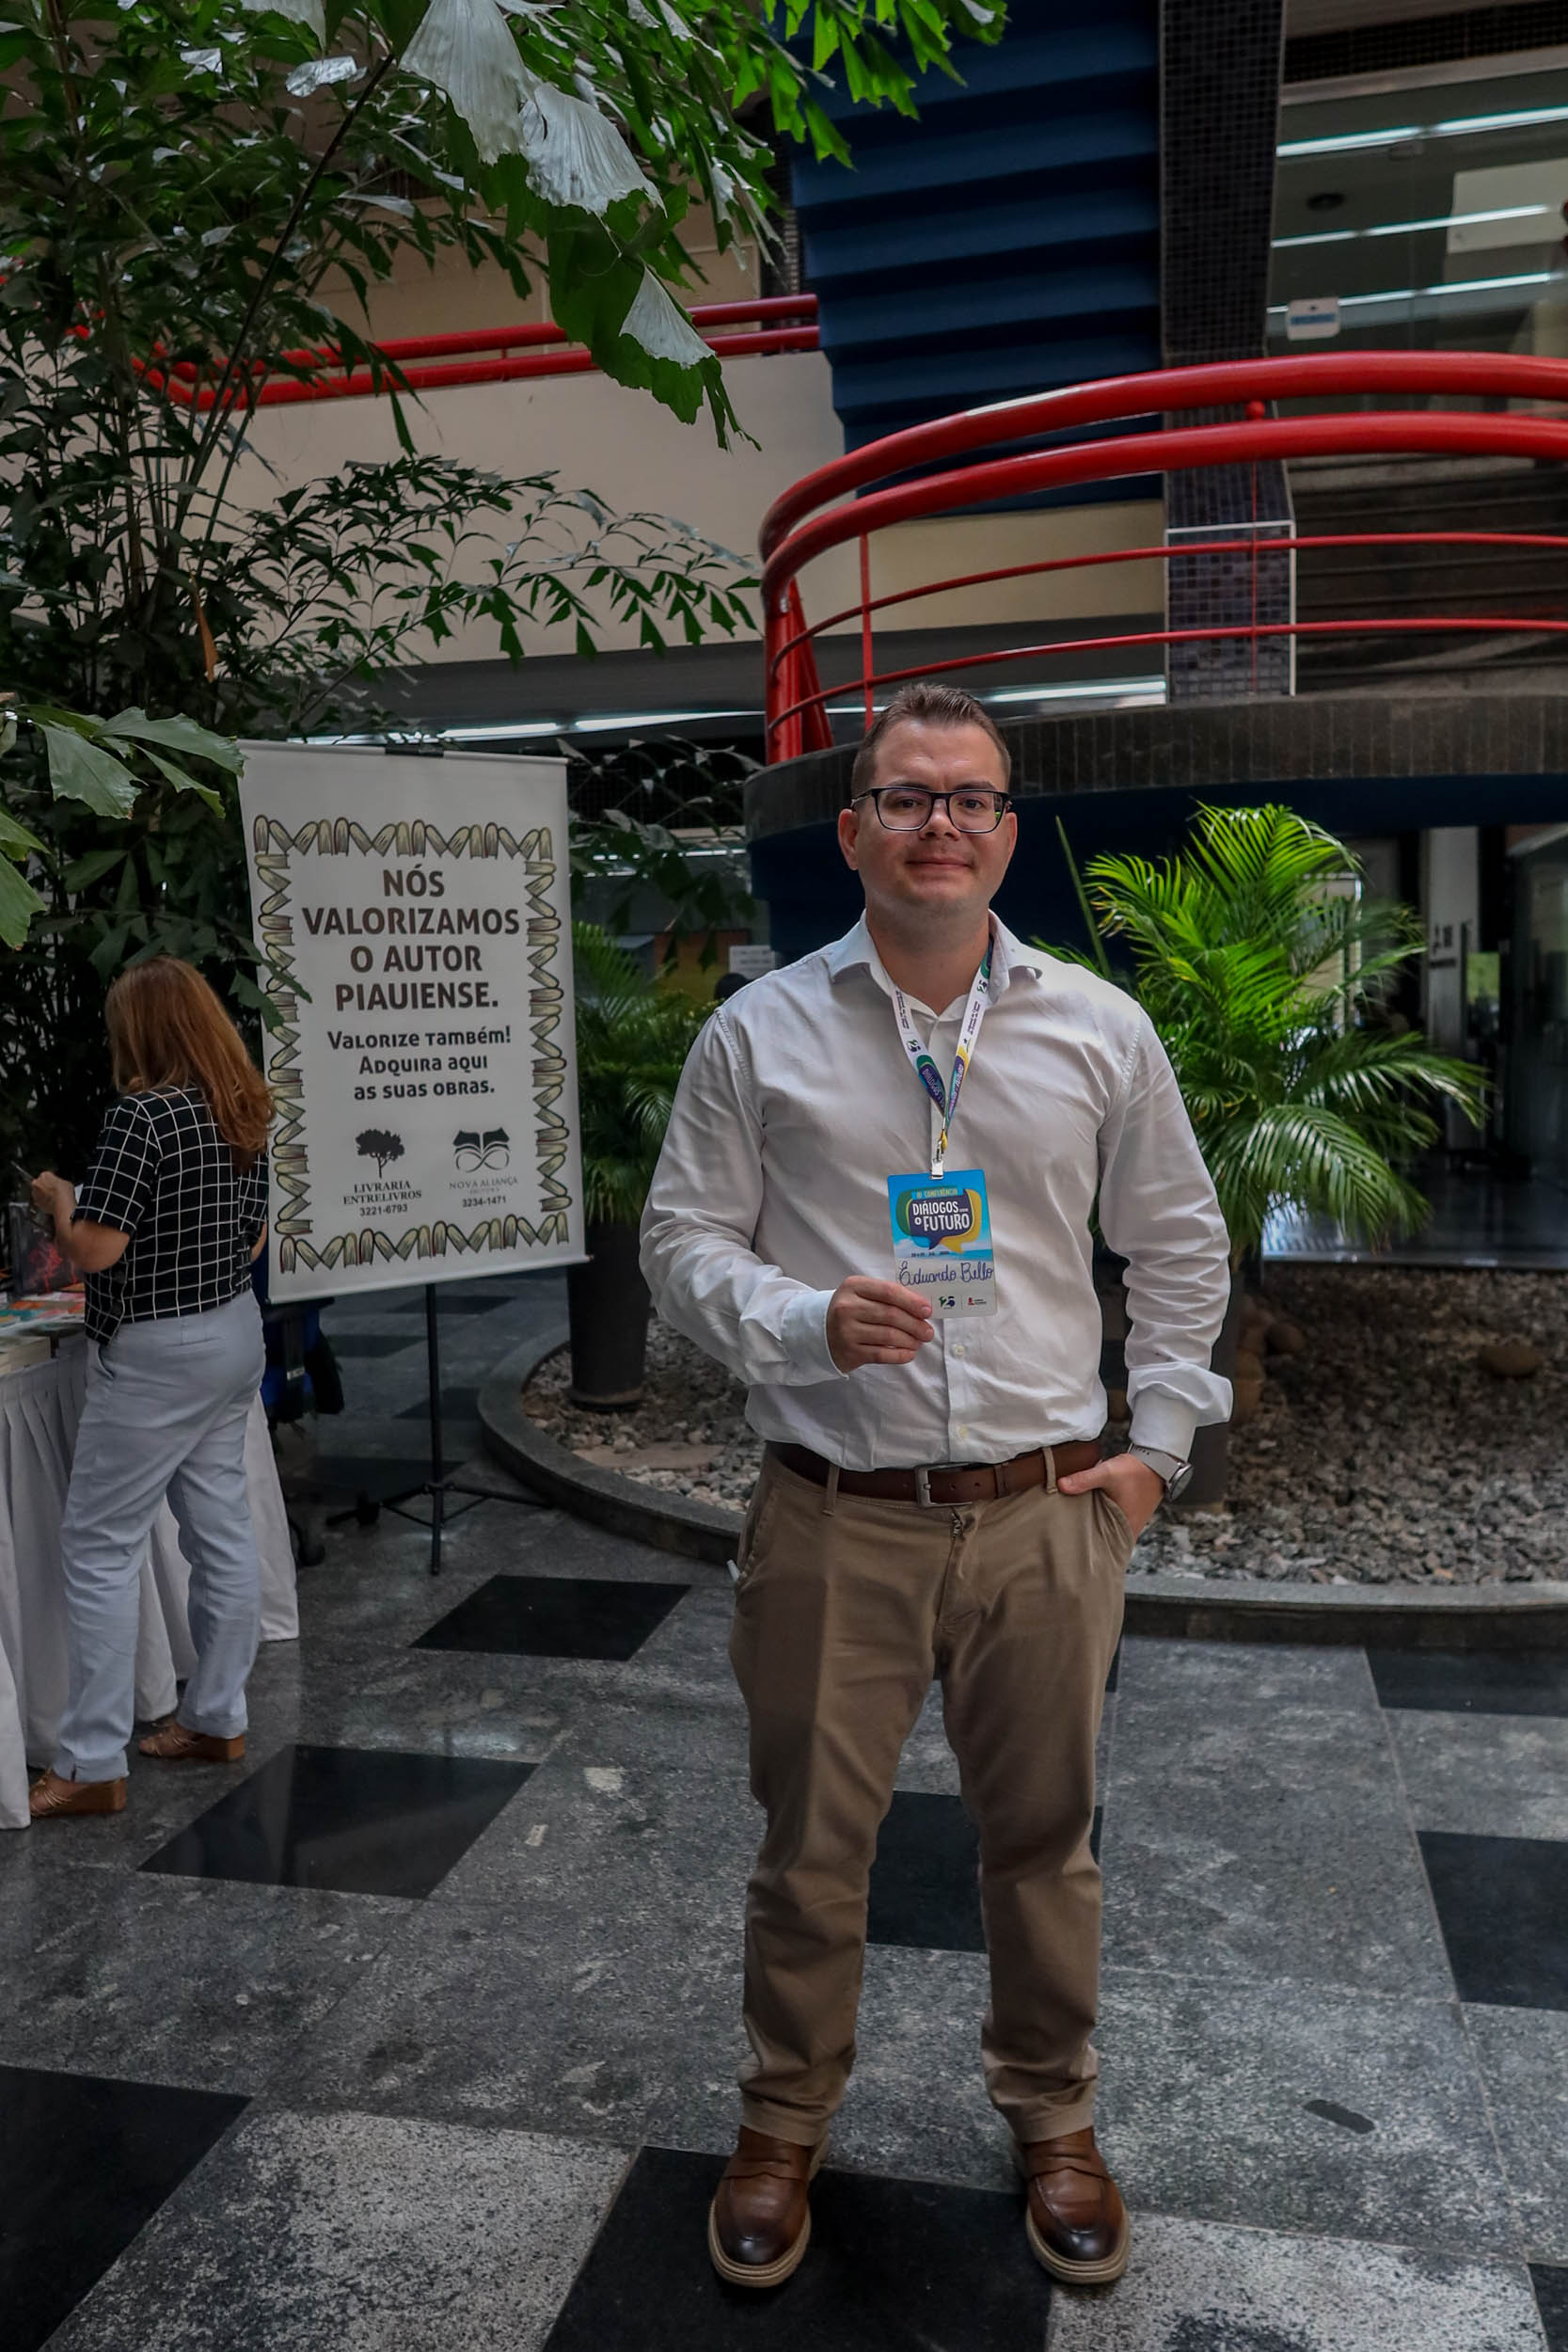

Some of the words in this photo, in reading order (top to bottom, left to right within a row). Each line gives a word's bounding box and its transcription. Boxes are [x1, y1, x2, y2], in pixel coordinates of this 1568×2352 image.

[383, 864, 445, 897] NÓS
[302, 907, 519, 935] VALORIZAMOS
[350, 946, 373, 973] O
[383, 945, 483, 972] AUTOR
[335, 982, 499, 1011] PIAUIENSE.
[354, 1086, 376, 1101] as
[383, 1083, 428, 1099] suas
[354, 1180, 411, 1193] LIVRARIA
[449, 1180, 479, 1190] NOVA
[343, 1189, 422, 1205] ENTRELIVROS
[462, 1195, 507, 1208] 3234-1471
[358, 1203, 407, 1216] 3221-6793
[912, 1200, 959, 1216] DIÁLOGOS
[923, 1213, 970, 1232] FUTURO
[899, 1261, 958, 1286] Eduardo
